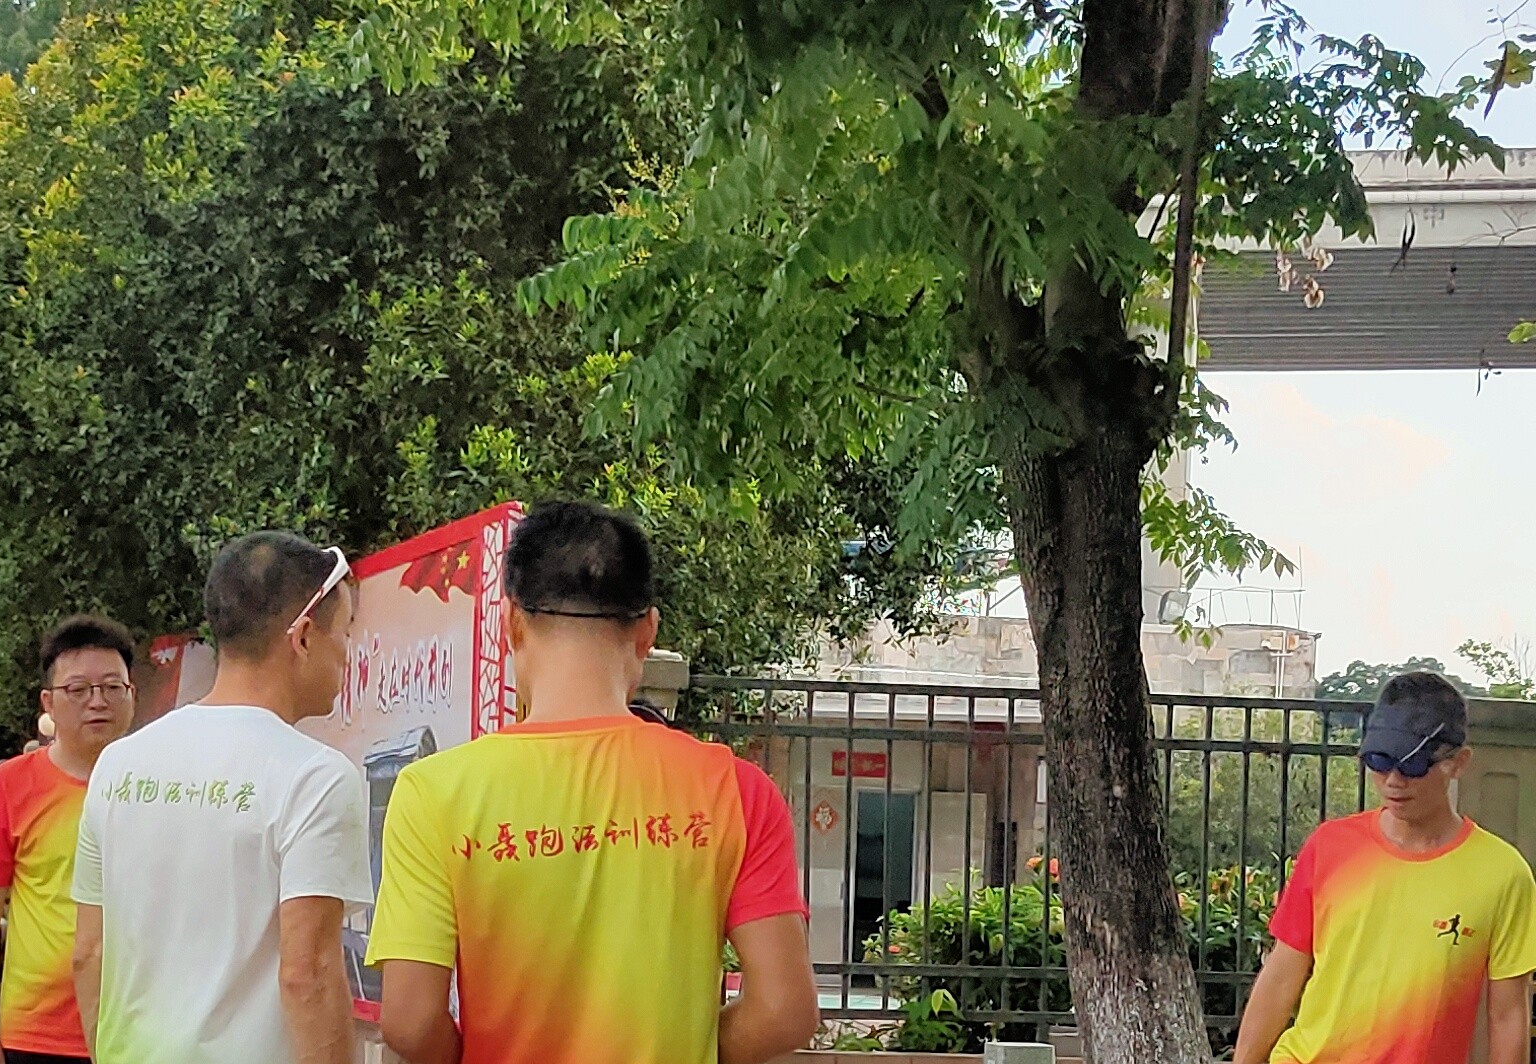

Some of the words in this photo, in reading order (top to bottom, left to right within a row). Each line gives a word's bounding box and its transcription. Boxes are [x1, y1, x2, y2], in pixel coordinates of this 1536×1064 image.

[452, 810, 712, 862] 小聂跑法训练营
